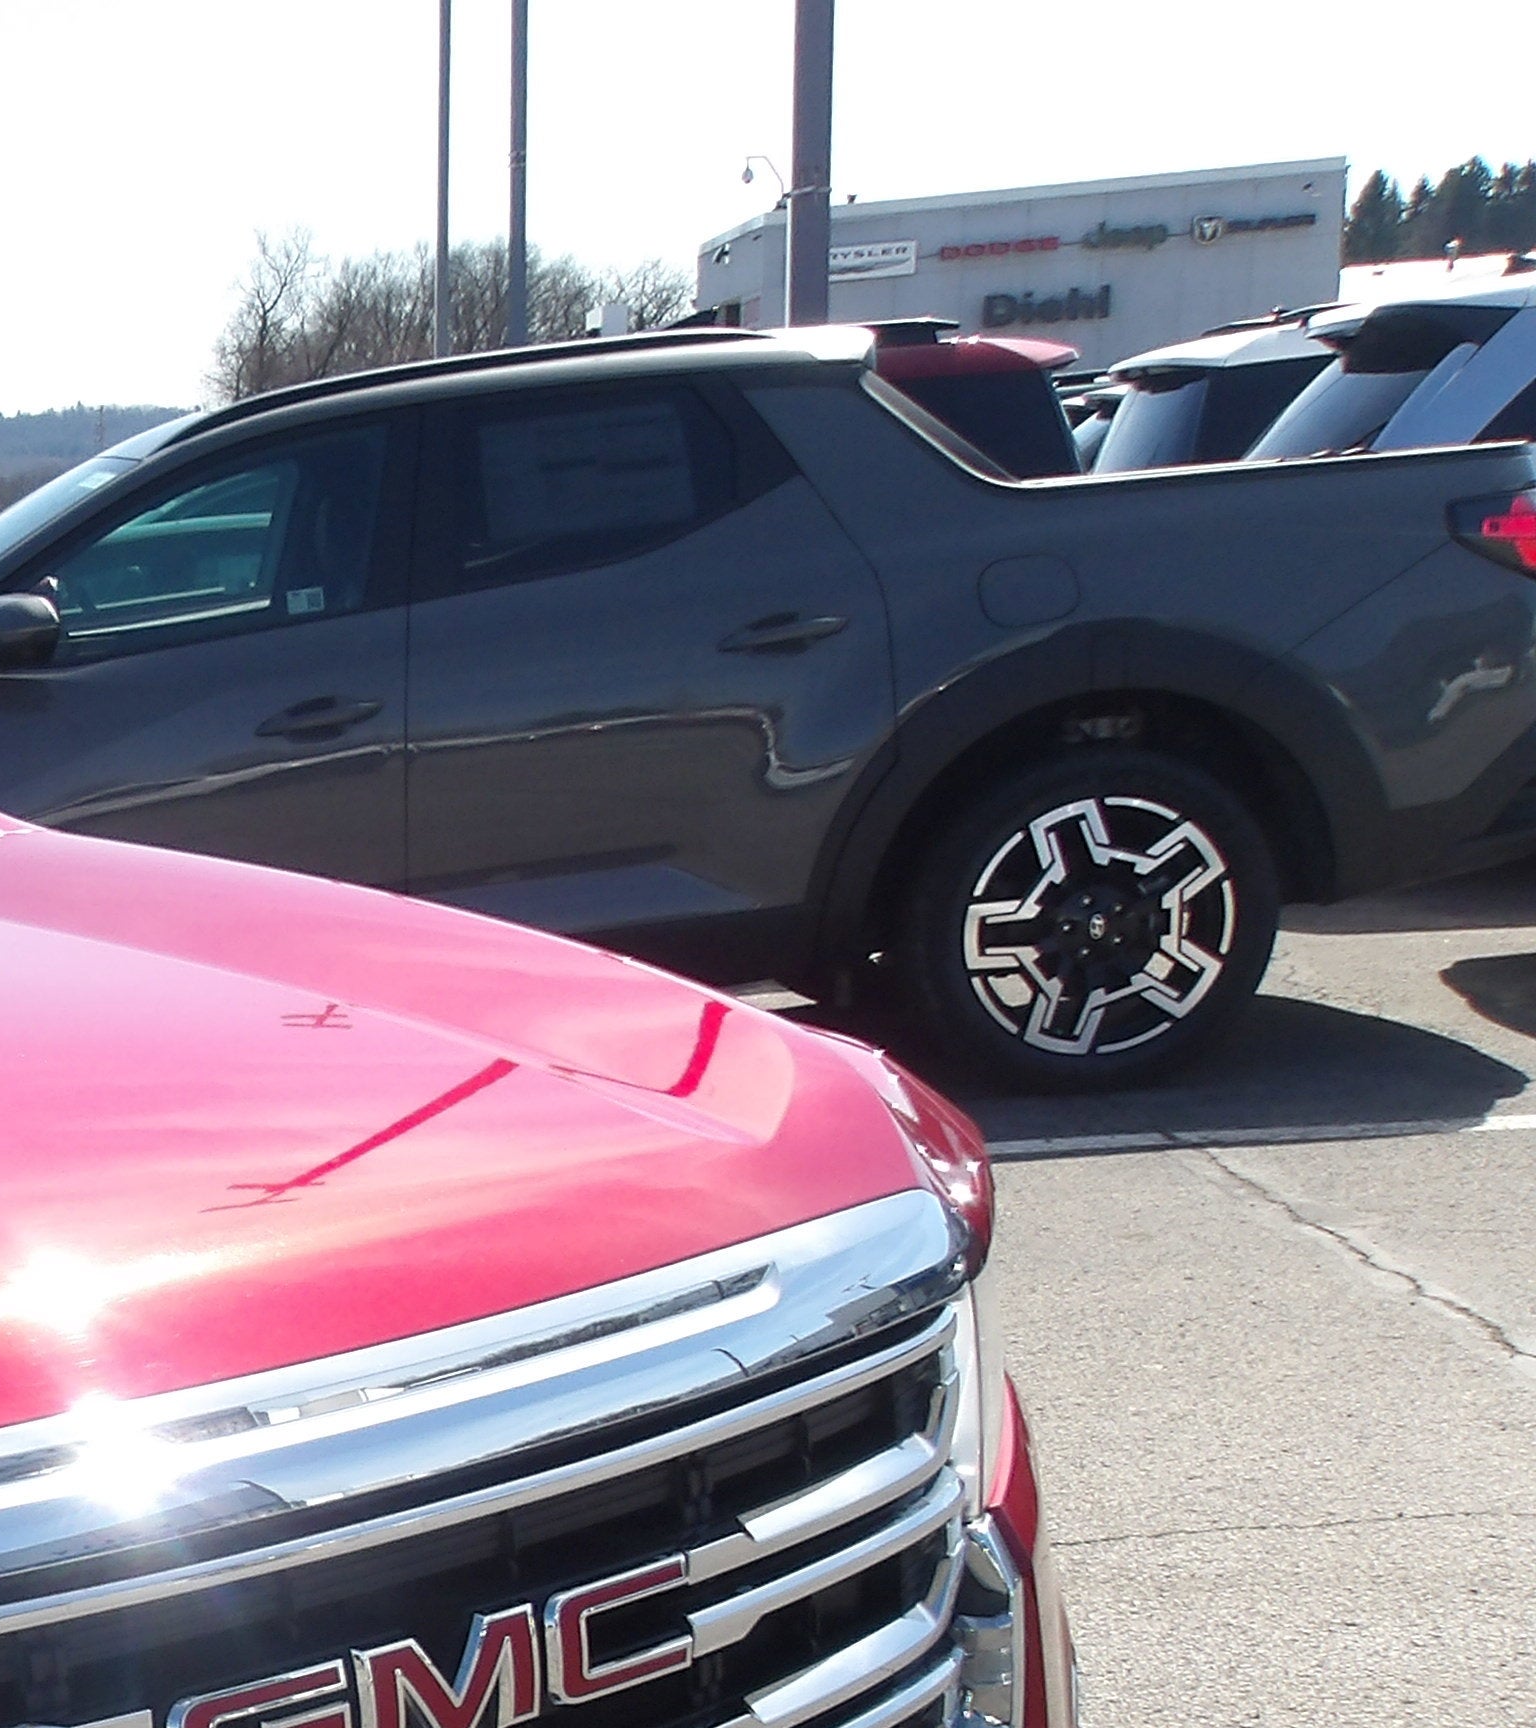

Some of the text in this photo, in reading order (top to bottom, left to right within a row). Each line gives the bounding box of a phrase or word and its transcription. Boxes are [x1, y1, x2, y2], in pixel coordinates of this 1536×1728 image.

[829, 246, 908, 260] RYSLER
[940, 236, 1061, 261] DODGE
[982, 284, 1111, 328] Diehl
